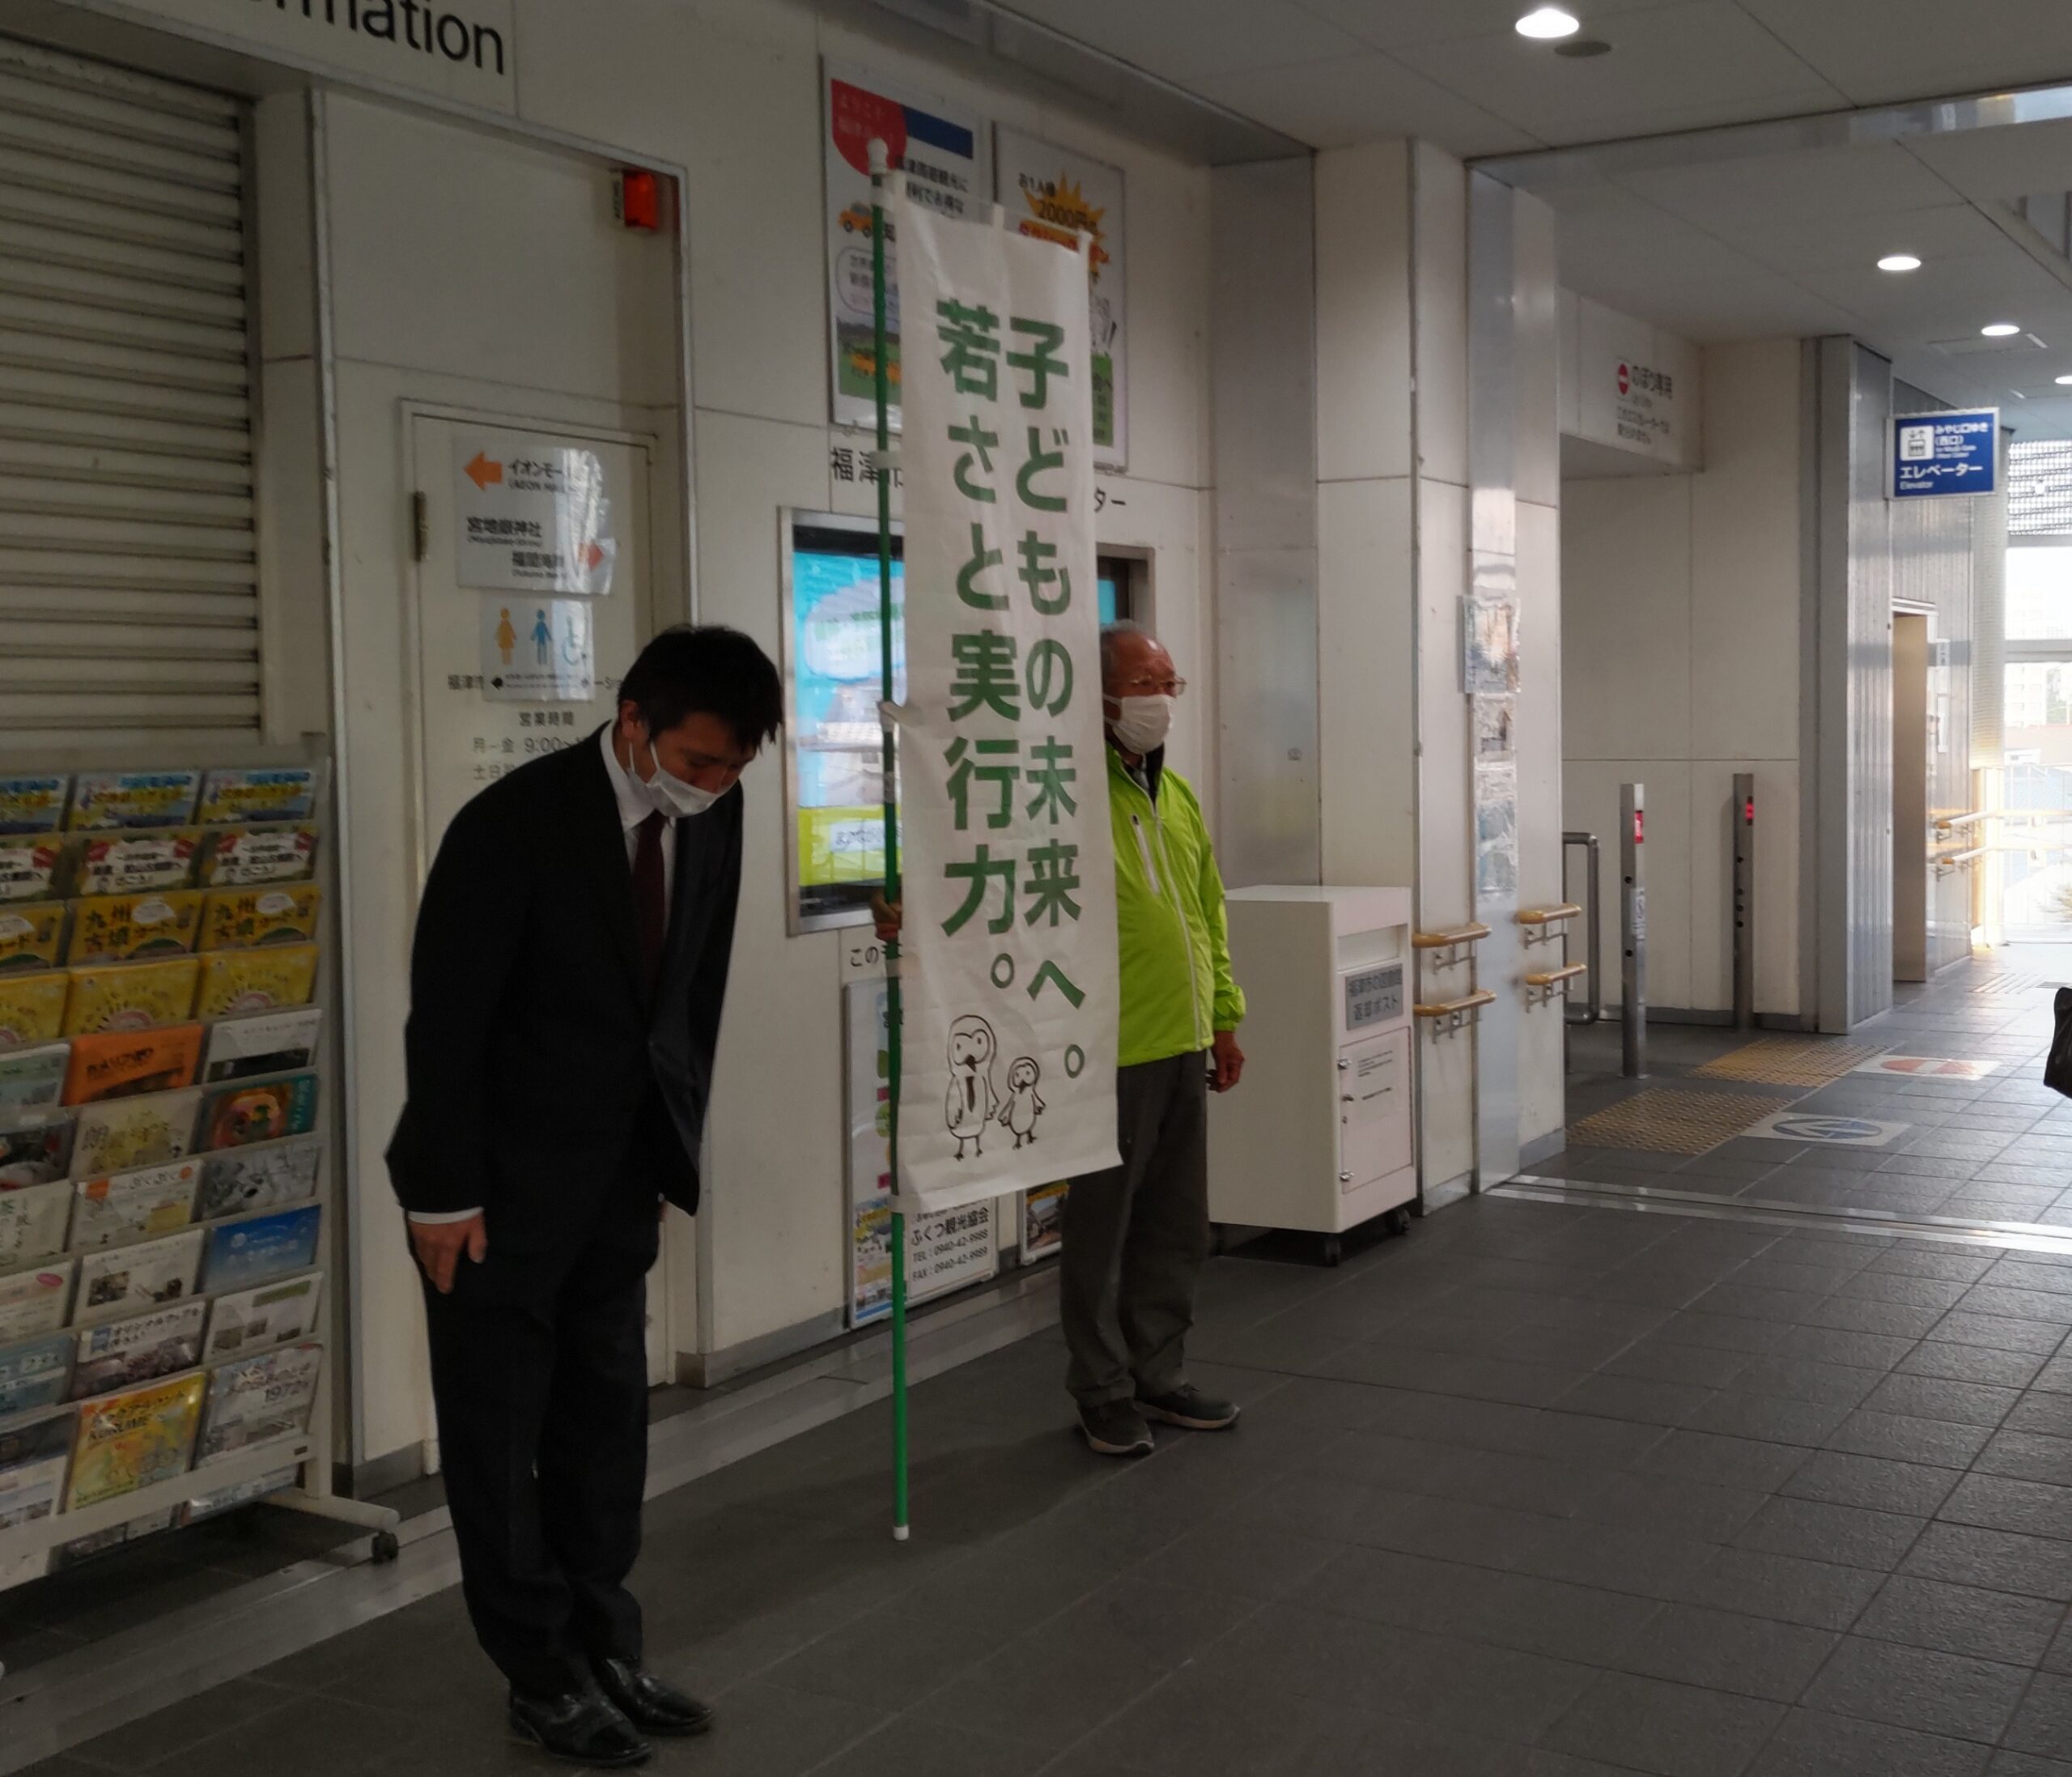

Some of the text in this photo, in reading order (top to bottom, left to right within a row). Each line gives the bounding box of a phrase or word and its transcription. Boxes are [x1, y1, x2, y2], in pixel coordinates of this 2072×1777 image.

[507, 458, 571, 480] イオンモー
[1900, 462, 1983, 479] エレベーター
[935, 298, 1021, 988] 若さと実行力。
[1006, 316, 1085, 1078] 子どもの未来へ。
[911, 1206, 989, 1247] ふくつ観光協会
